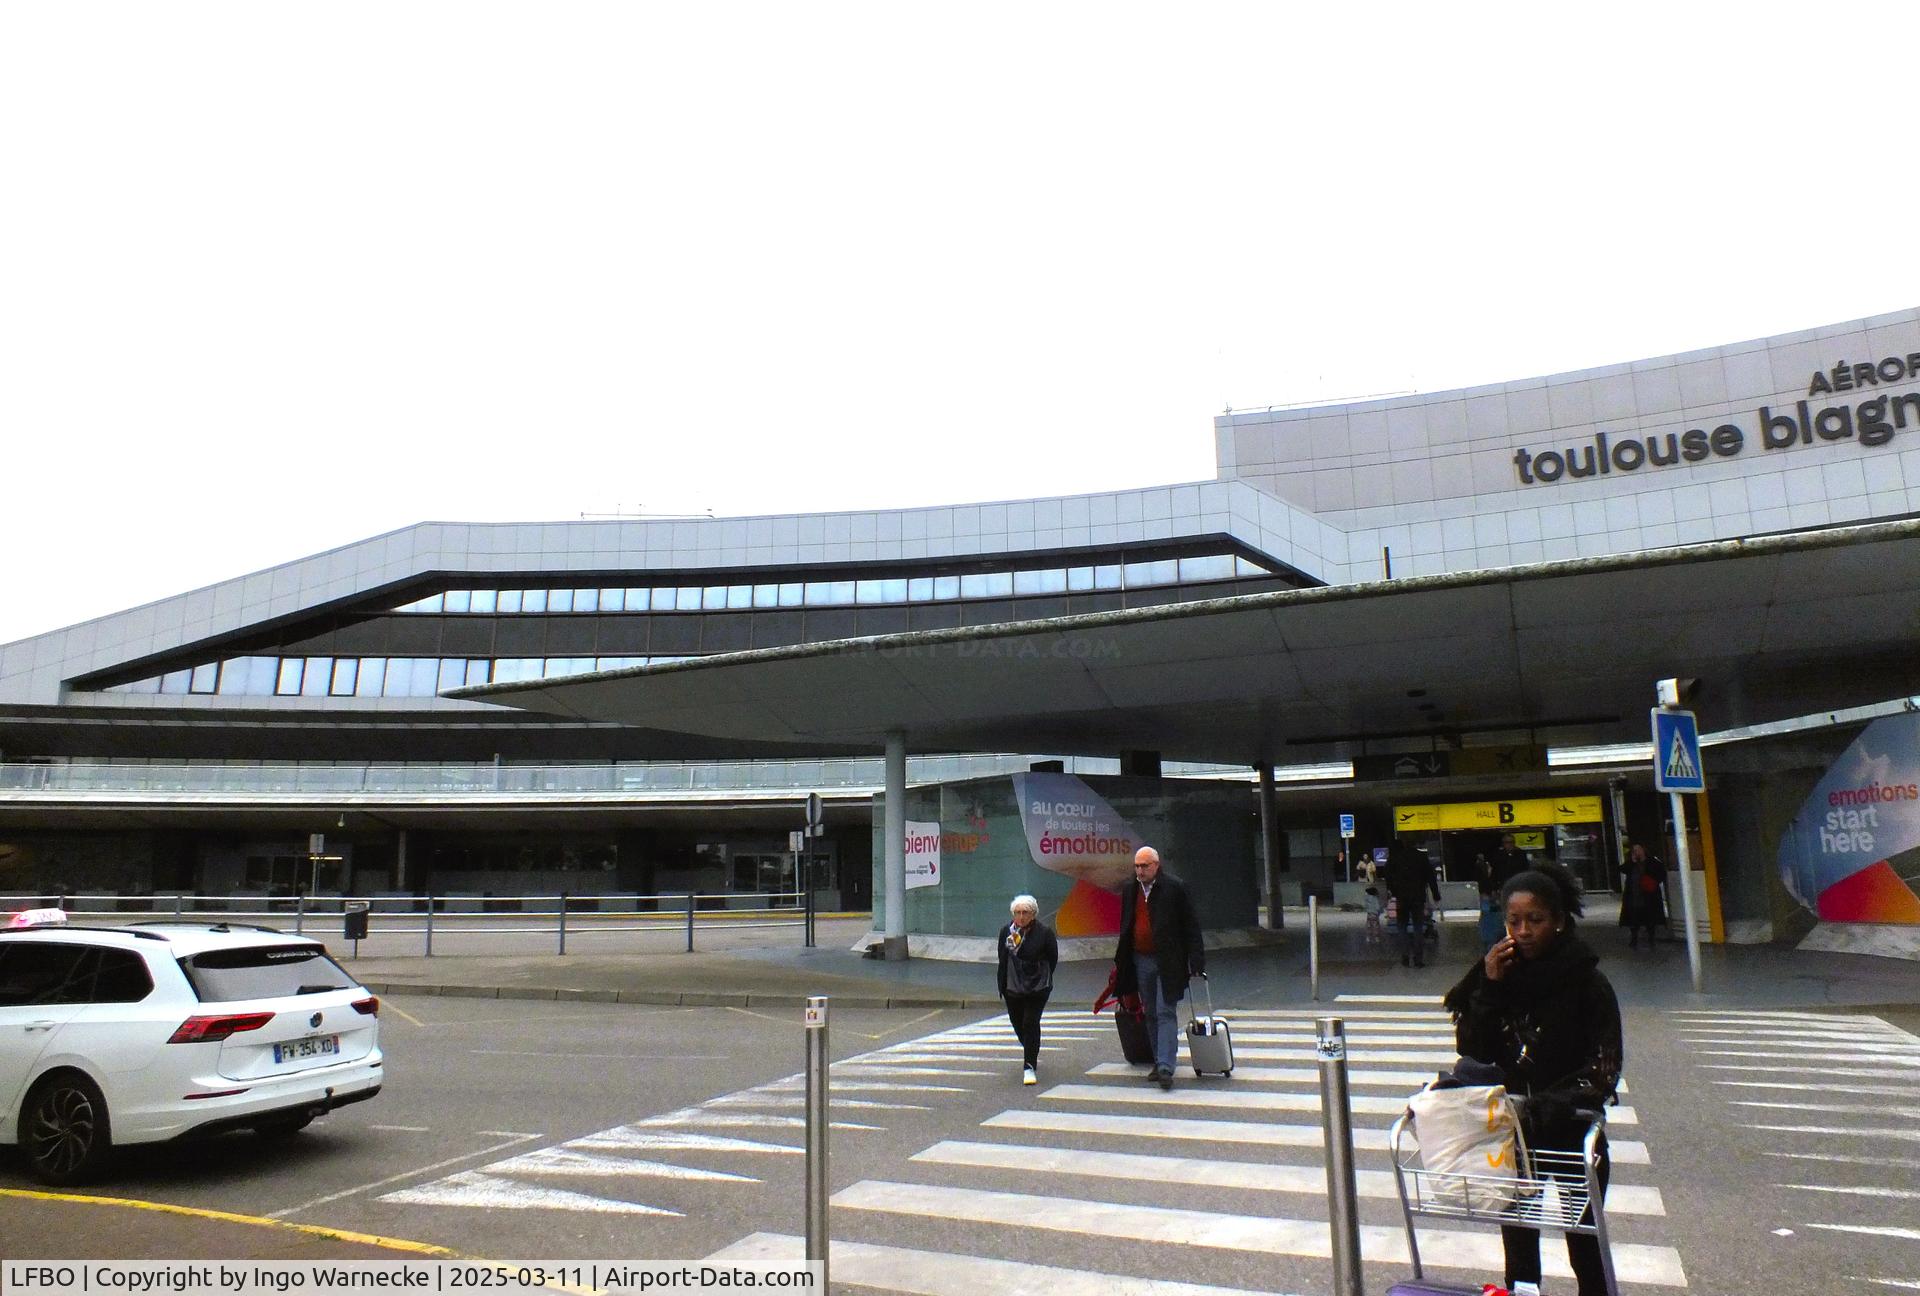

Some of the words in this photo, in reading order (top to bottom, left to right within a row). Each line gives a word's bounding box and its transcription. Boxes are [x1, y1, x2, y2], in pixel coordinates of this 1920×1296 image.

[1513, 424, 1744, 484] toulouse
[1828, 781, 1918, 807] emotions
[1032, 801, 1052, 817] au
[1055, 803, 1095, 817] cœur
[1499, 803, 1515, 824] B
[1826, 804, 1878, 831] start
[1045, 818, 1058, 830] de
[1061, 819, 1092, 832] toutes
[1040, 831, 1131, 855] émotions
[1820, 826, 1874, 853] here
